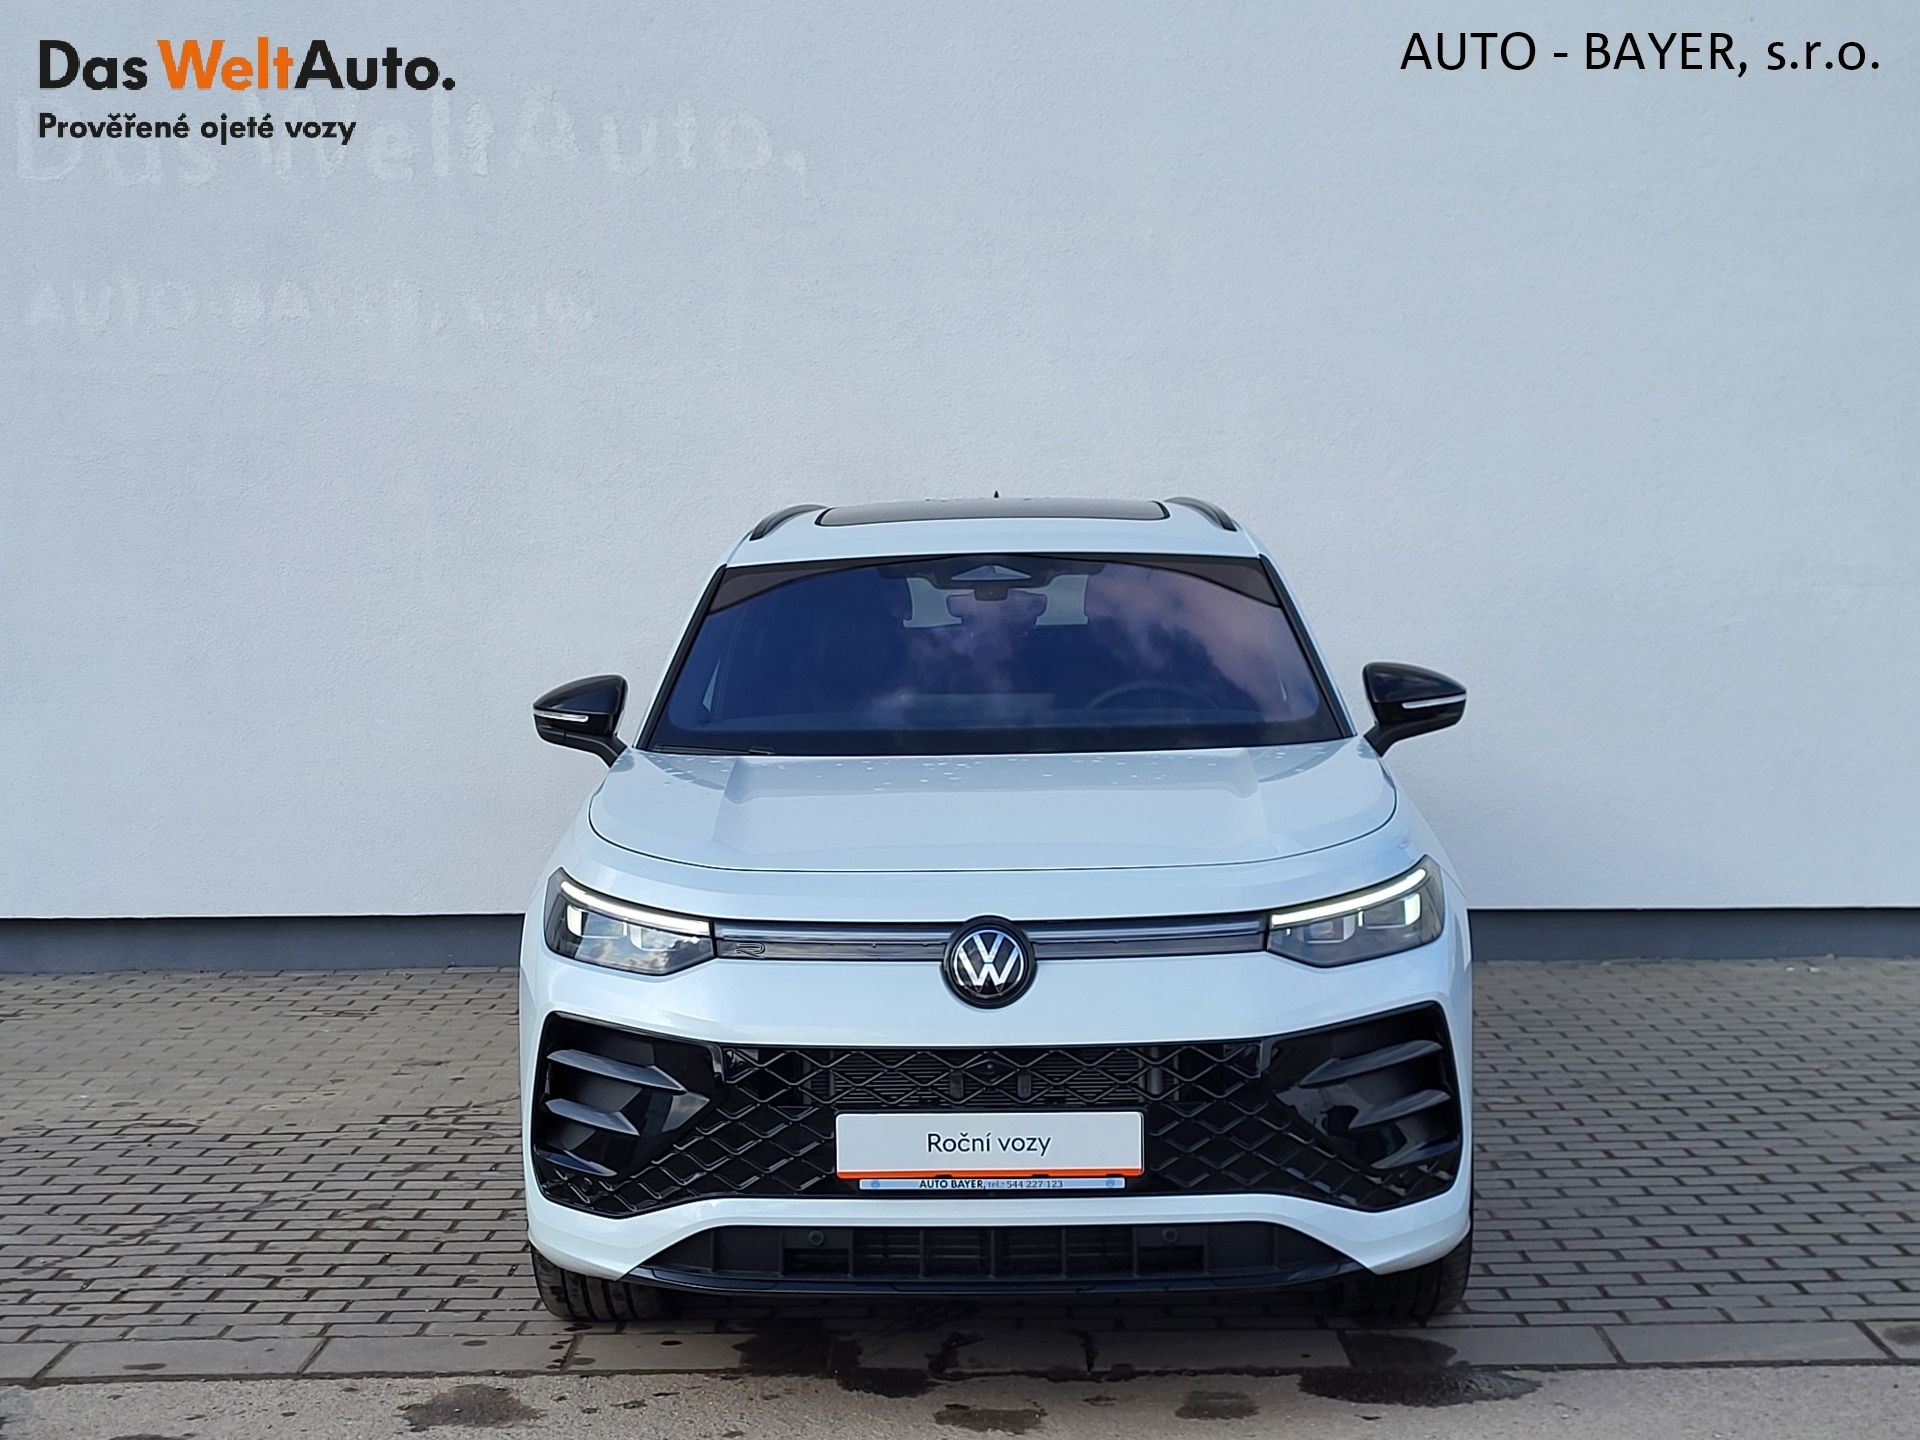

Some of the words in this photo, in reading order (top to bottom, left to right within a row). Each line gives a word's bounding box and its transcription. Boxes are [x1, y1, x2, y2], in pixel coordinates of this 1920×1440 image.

[927, 1132, 991, 1153] Roční
[998, 1137, 1051, 1157] vozy
[919, 1180, 948, 1189] AUTO
[951, 1180, 986, 1190] BAYER,
[1007, 1180, 1024, 1188] 544
[1026, 1180, 1043, 1188] 227
[1047, 1180, 1063, 1188] 123
